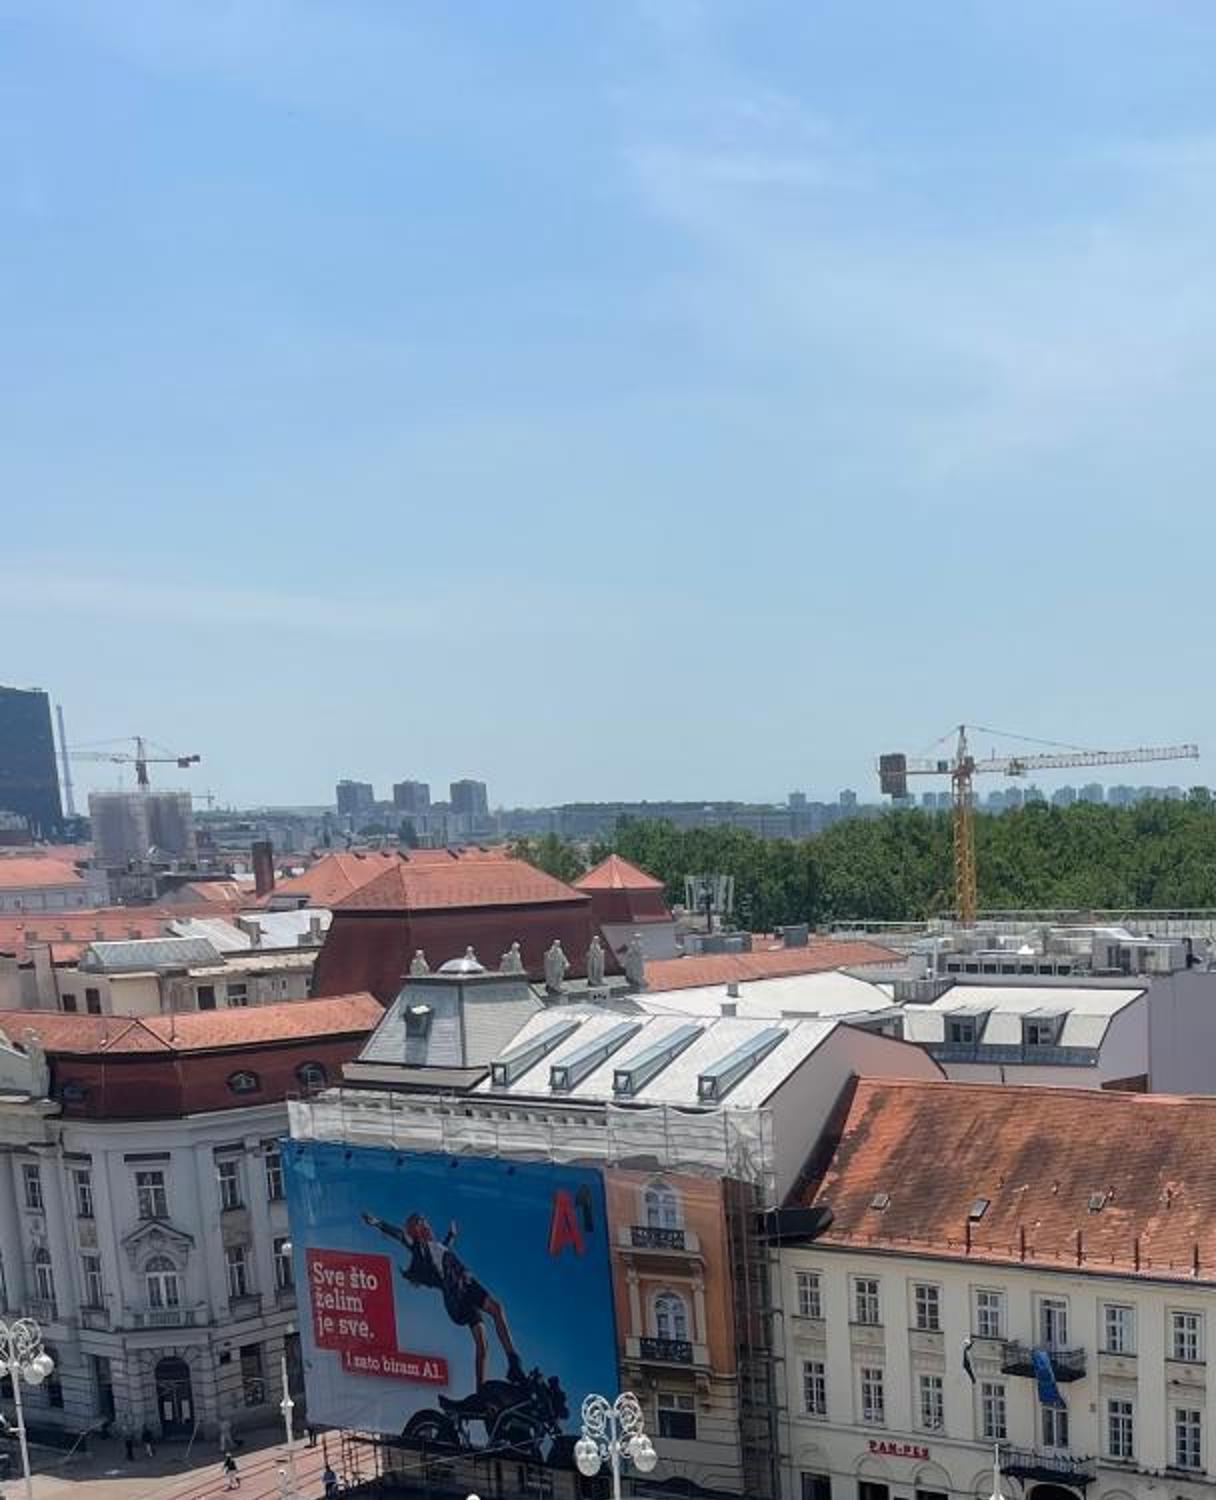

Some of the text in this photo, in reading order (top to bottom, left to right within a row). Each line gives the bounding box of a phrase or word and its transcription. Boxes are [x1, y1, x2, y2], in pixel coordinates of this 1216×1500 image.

[312, 1261, 379, 1290] Sve što
[315, 1286, 364, 1313] želim
[317, 1310, 375, 1338] je sve.
[353, 1355, 381, 1371] zato
[382, 1354, 420, 1376] biram
